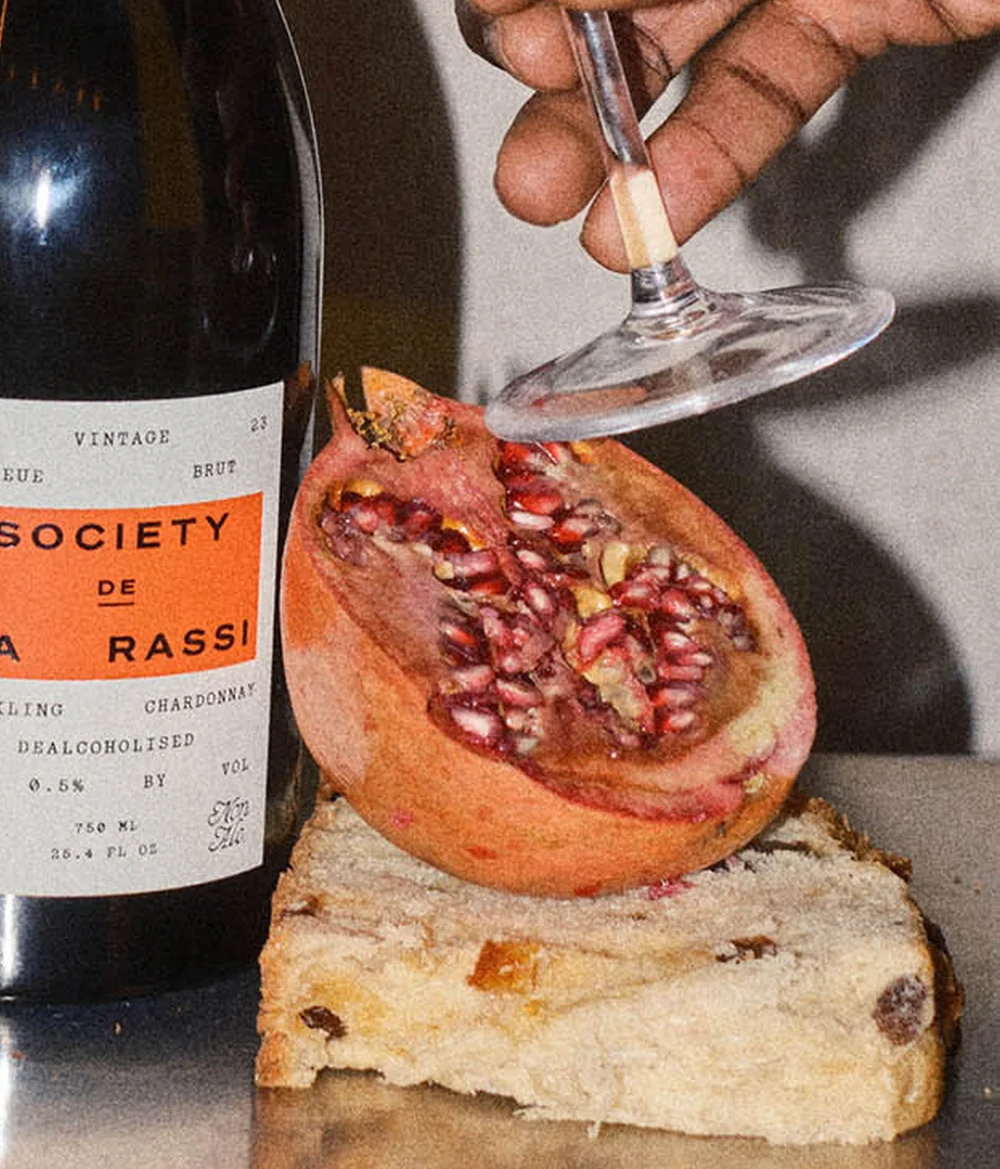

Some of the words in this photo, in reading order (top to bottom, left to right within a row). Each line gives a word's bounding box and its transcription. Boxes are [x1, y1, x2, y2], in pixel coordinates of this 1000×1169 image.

[74, 429, 170, 446] VINTAGE
[250, 416, 268, 433] 23
[192, 460, 237, 479] BRUT
[97, 579, 136, 596] DE
[108, 619, 249, 663] RASSI
[144, 682, 256, 714] CHARDONNAY
[17, 732, 195, 756] DEALCOHOLISED
[29, 777, 85, 793] 0.5%
[143, 773, 166, 789] BY
[222, 758, 250, 776] VOL
[74, 822, 106, 834] 750
[118, 820, 139, 832] ML
[107, 846, 127, 859] FL
[139, 843, 158, 856] OZ
